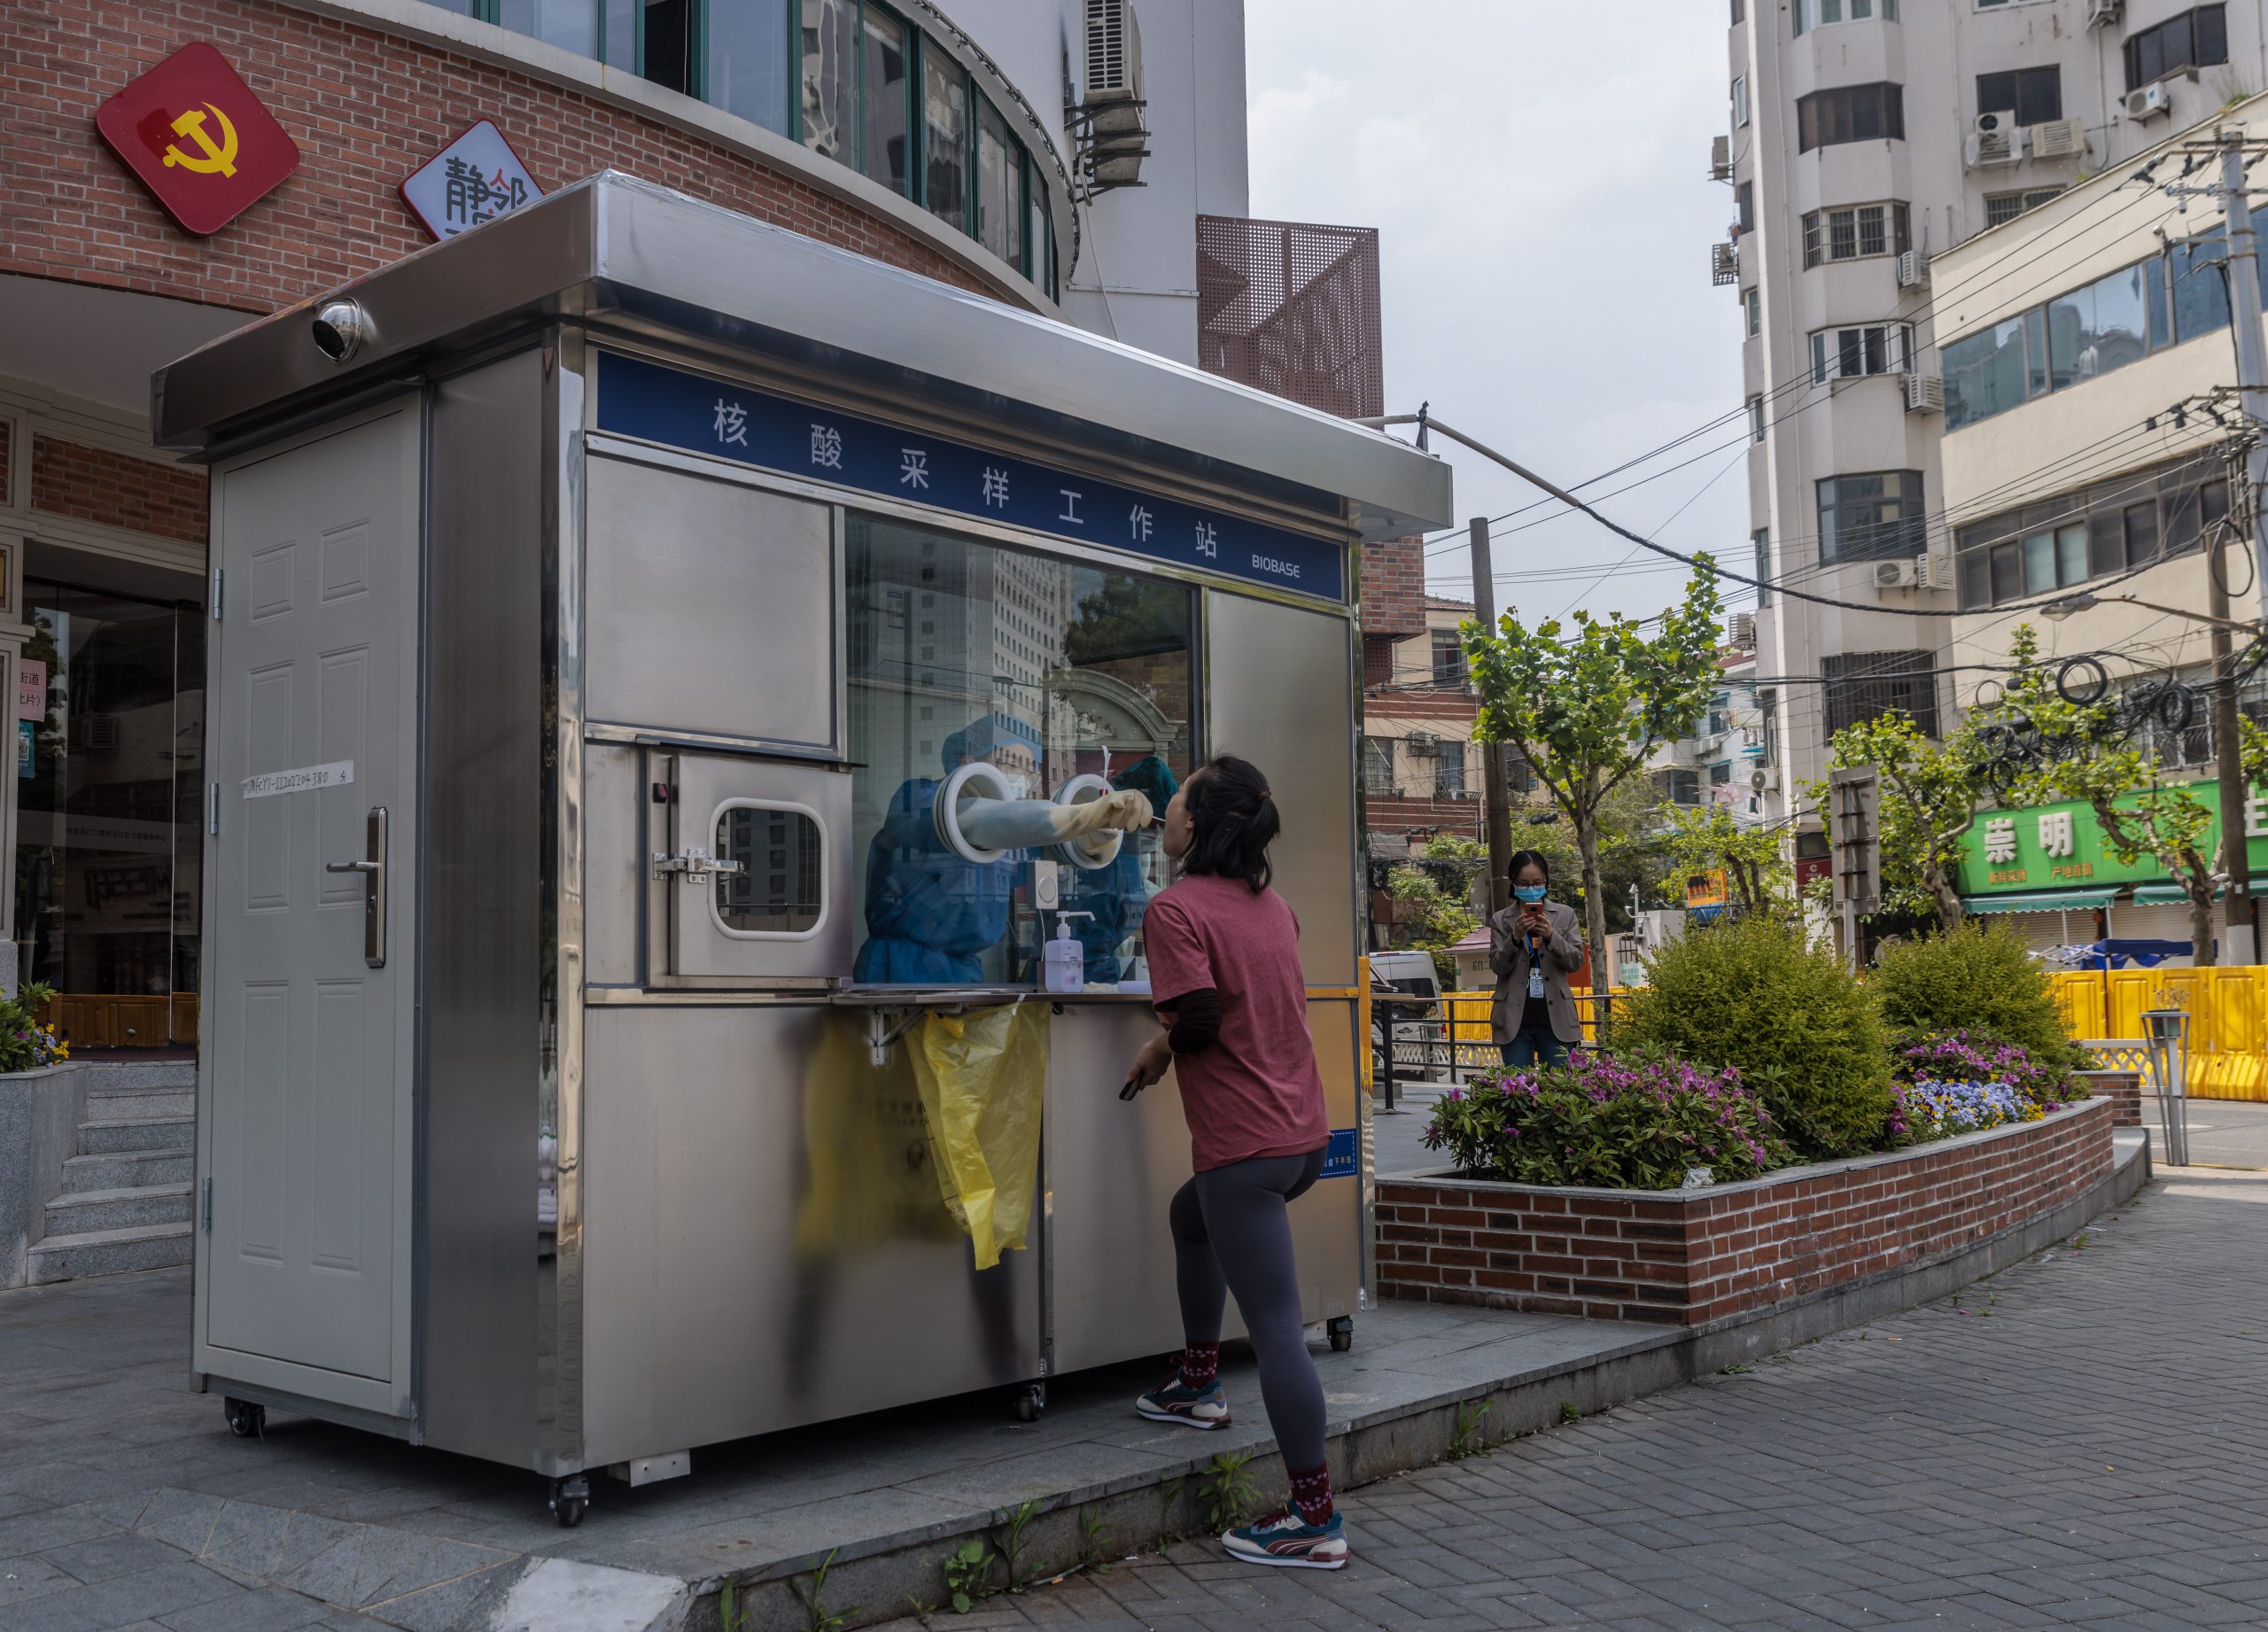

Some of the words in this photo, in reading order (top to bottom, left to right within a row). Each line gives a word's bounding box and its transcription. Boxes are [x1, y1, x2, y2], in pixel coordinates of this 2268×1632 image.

[713, 398, 1217, 558] 核酸采样工作站
[1252, 554, 1301, 579] BIOBASE
[1984, 811, 2074, 864] 崇明
